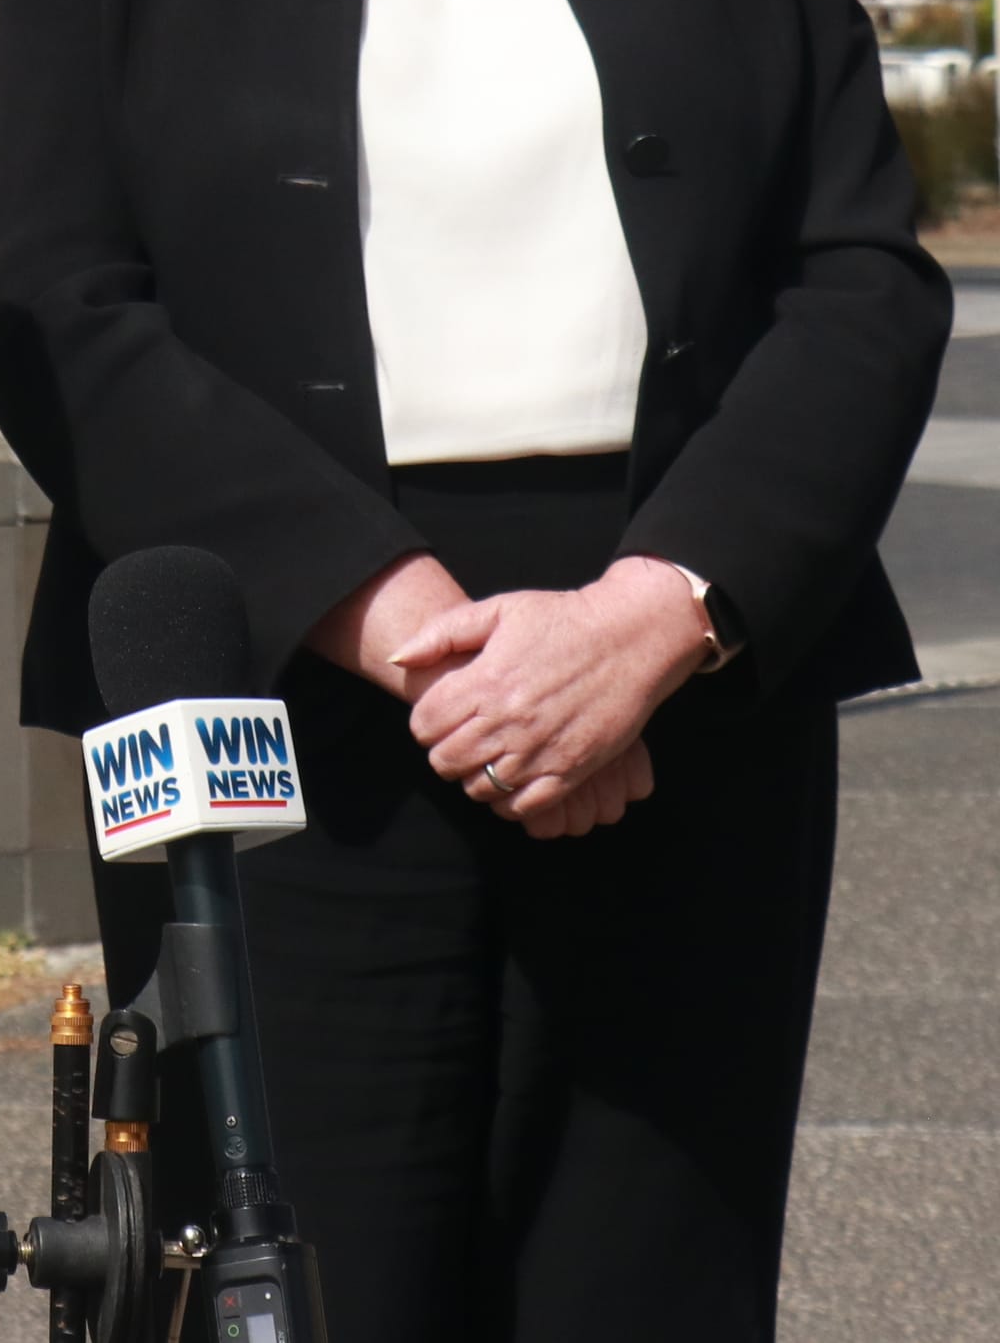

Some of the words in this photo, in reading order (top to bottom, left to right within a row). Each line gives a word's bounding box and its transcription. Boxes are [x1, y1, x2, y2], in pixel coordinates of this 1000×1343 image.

[91, 722, 175, 792] WIN
[195, 716, 289, 766] WIN
[101, 777, 181, 827] NEWS
[207, 769, 296, 799] NEWS
